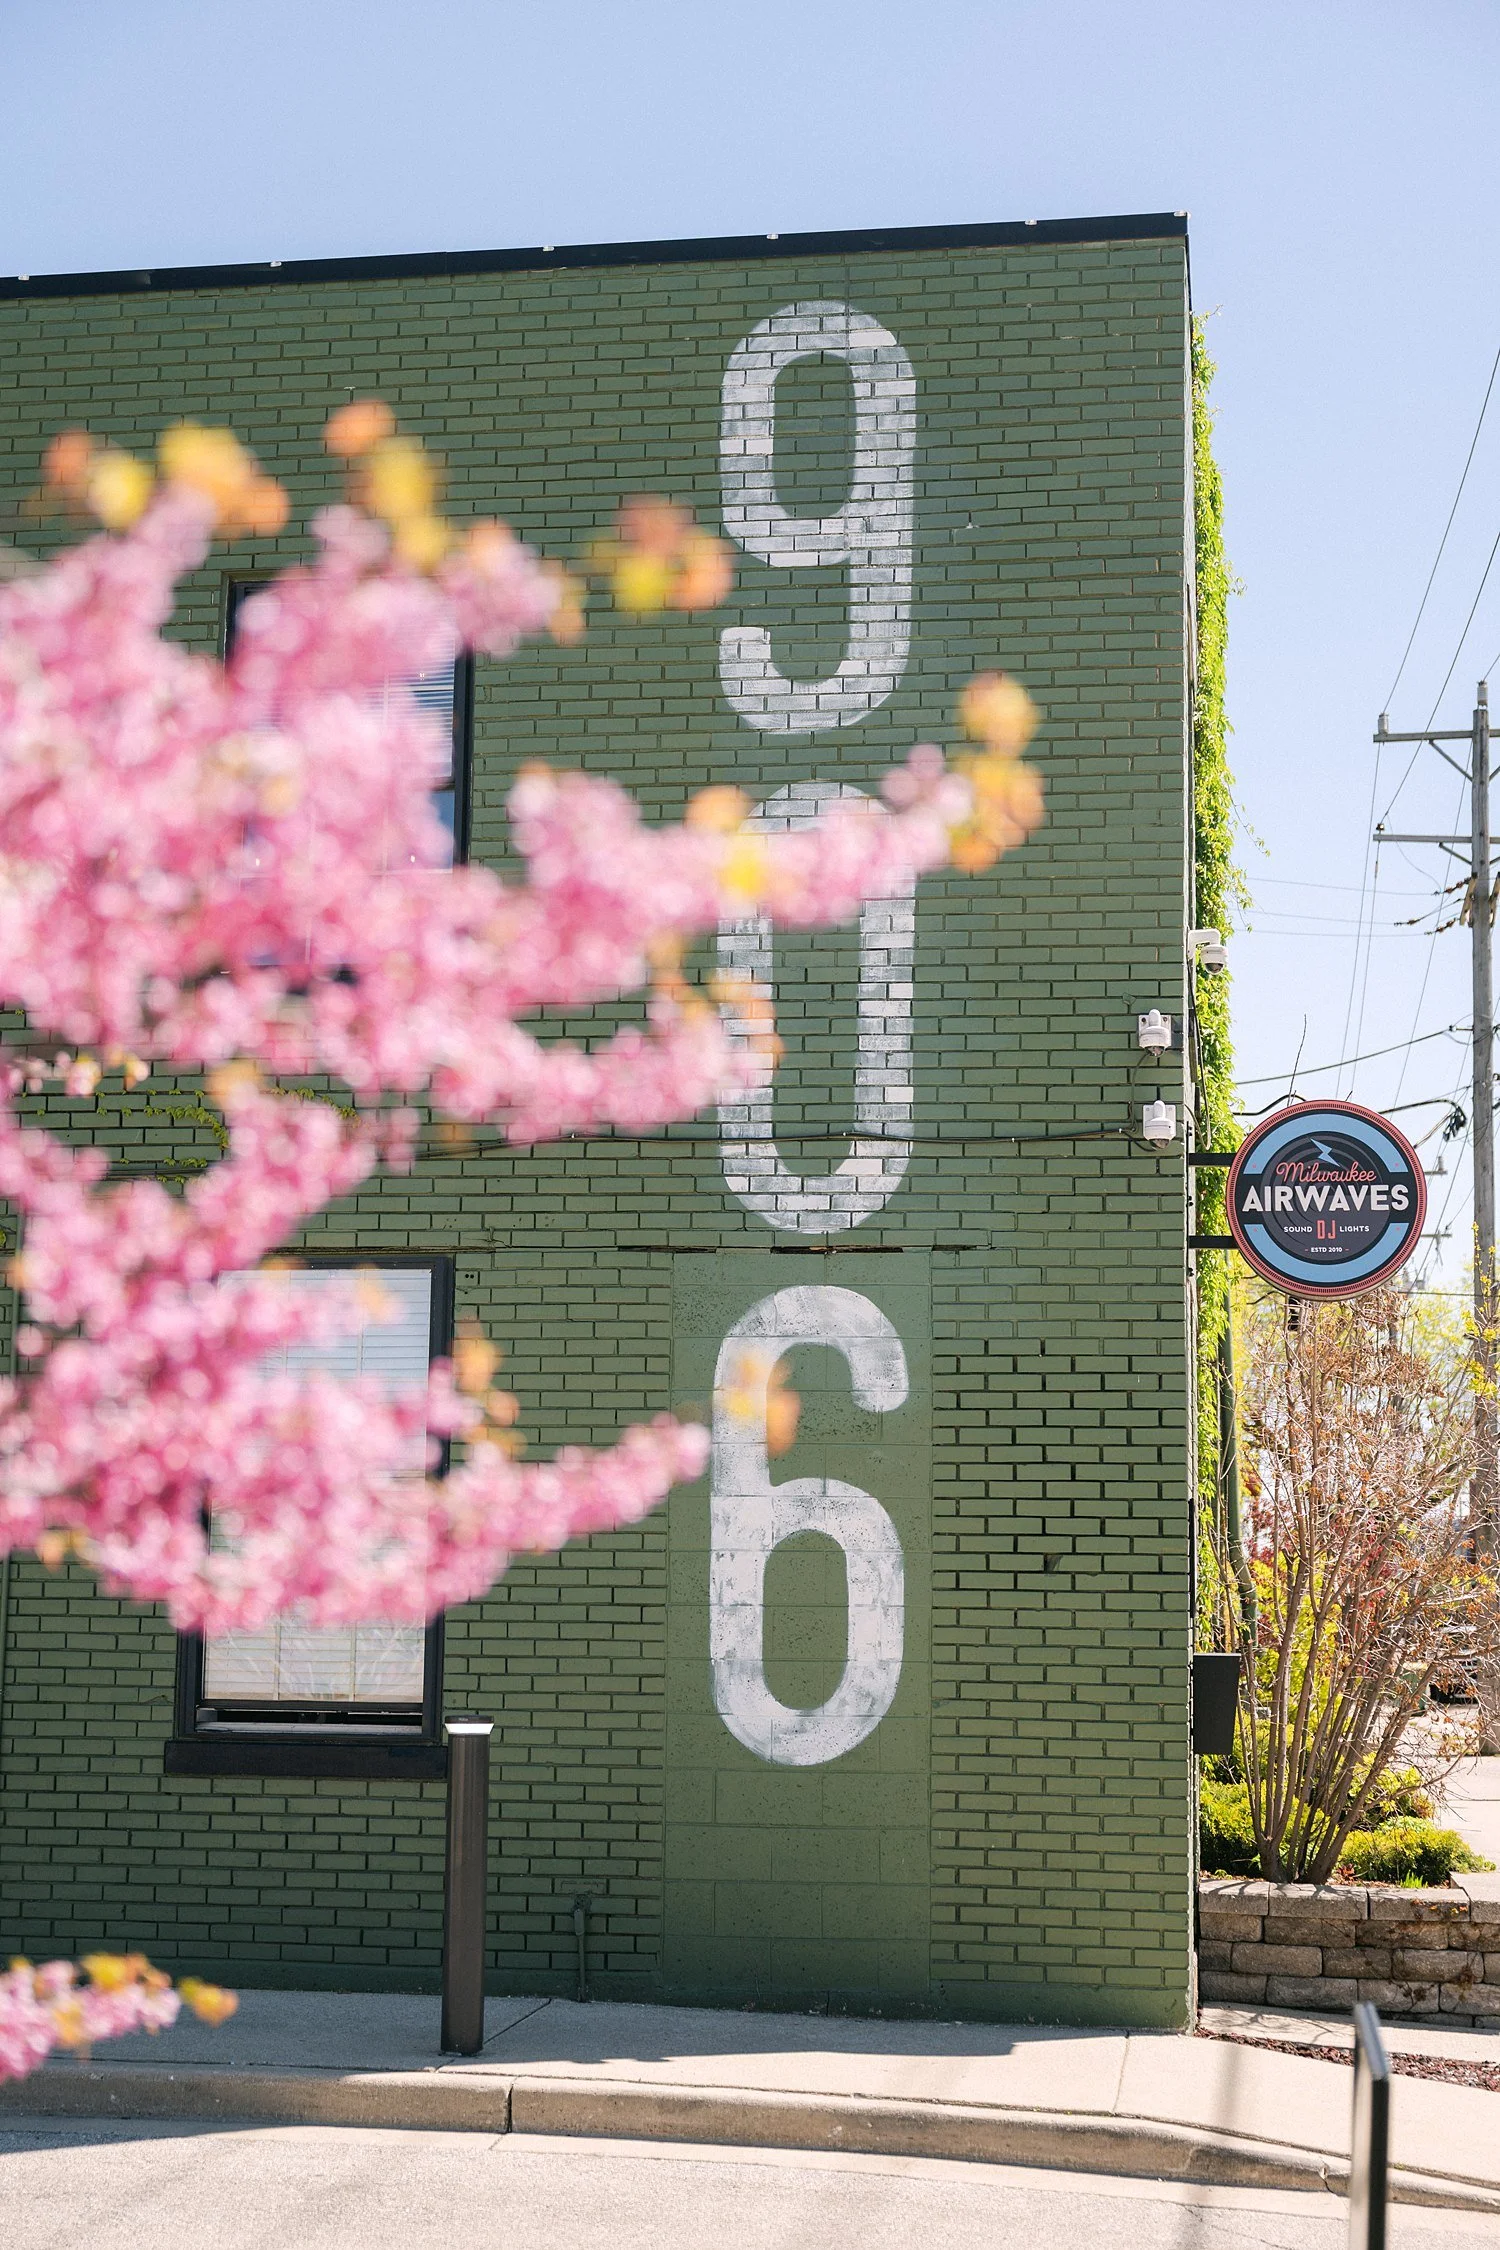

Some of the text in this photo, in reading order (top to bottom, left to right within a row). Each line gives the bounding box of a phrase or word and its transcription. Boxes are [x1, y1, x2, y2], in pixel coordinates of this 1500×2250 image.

[1276, 1161, 1377, 1183] Milwaukee
[1242, 1184, 1409, 1212] AIRWAVES
[1316, 1219, 1336, 1240] DJ
[1339, 1225, 1370, 1233] LIGHTS
